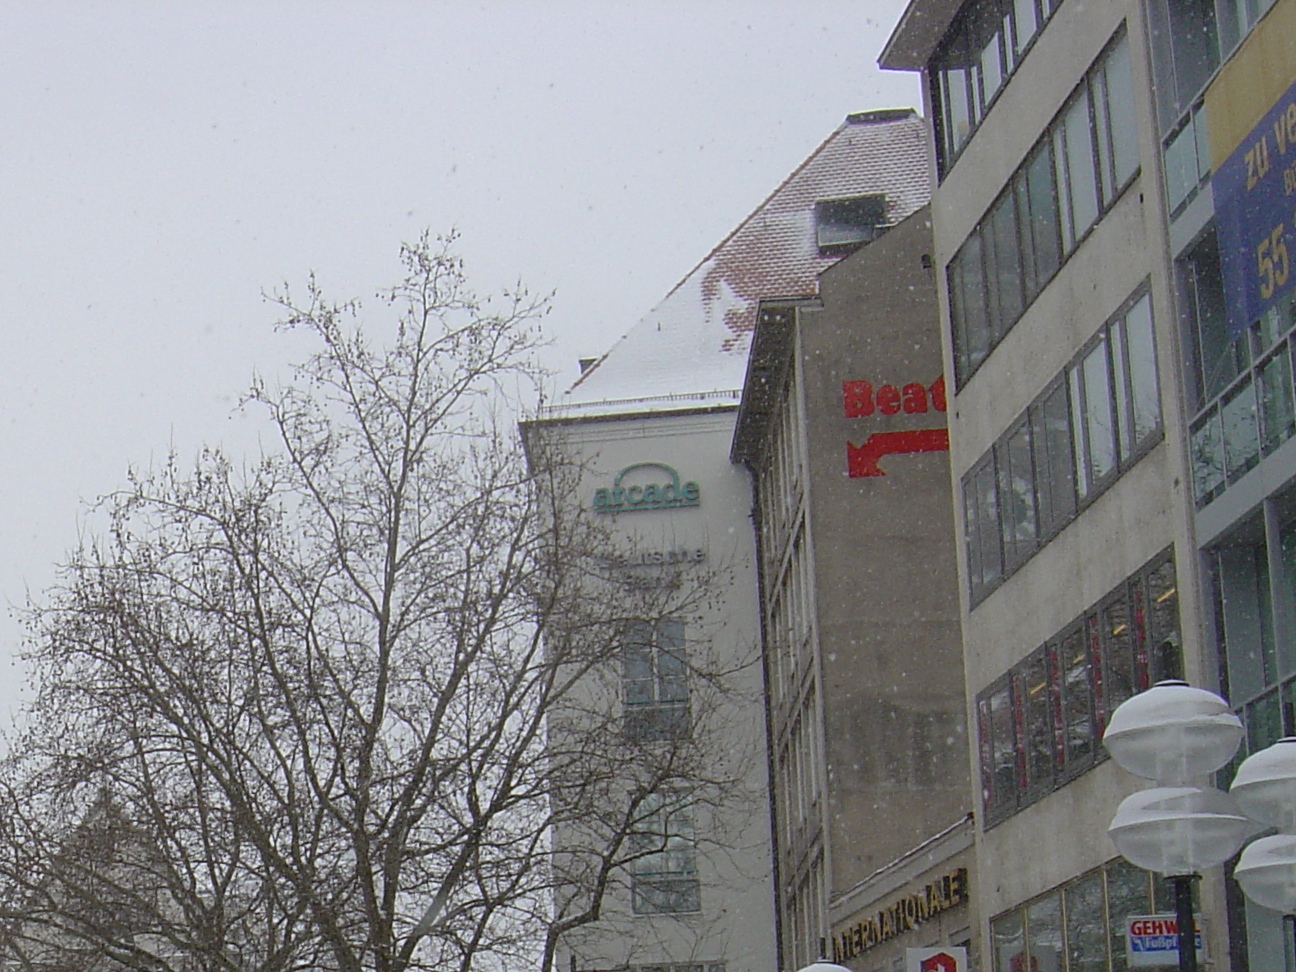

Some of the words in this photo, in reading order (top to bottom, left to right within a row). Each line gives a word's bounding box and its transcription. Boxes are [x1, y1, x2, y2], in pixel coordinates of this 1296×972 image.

[1257, 223, 1290, 300] 55
[593, 462, 700, 508] arcade
[1130, 919, 1201, 937] GEHWL
